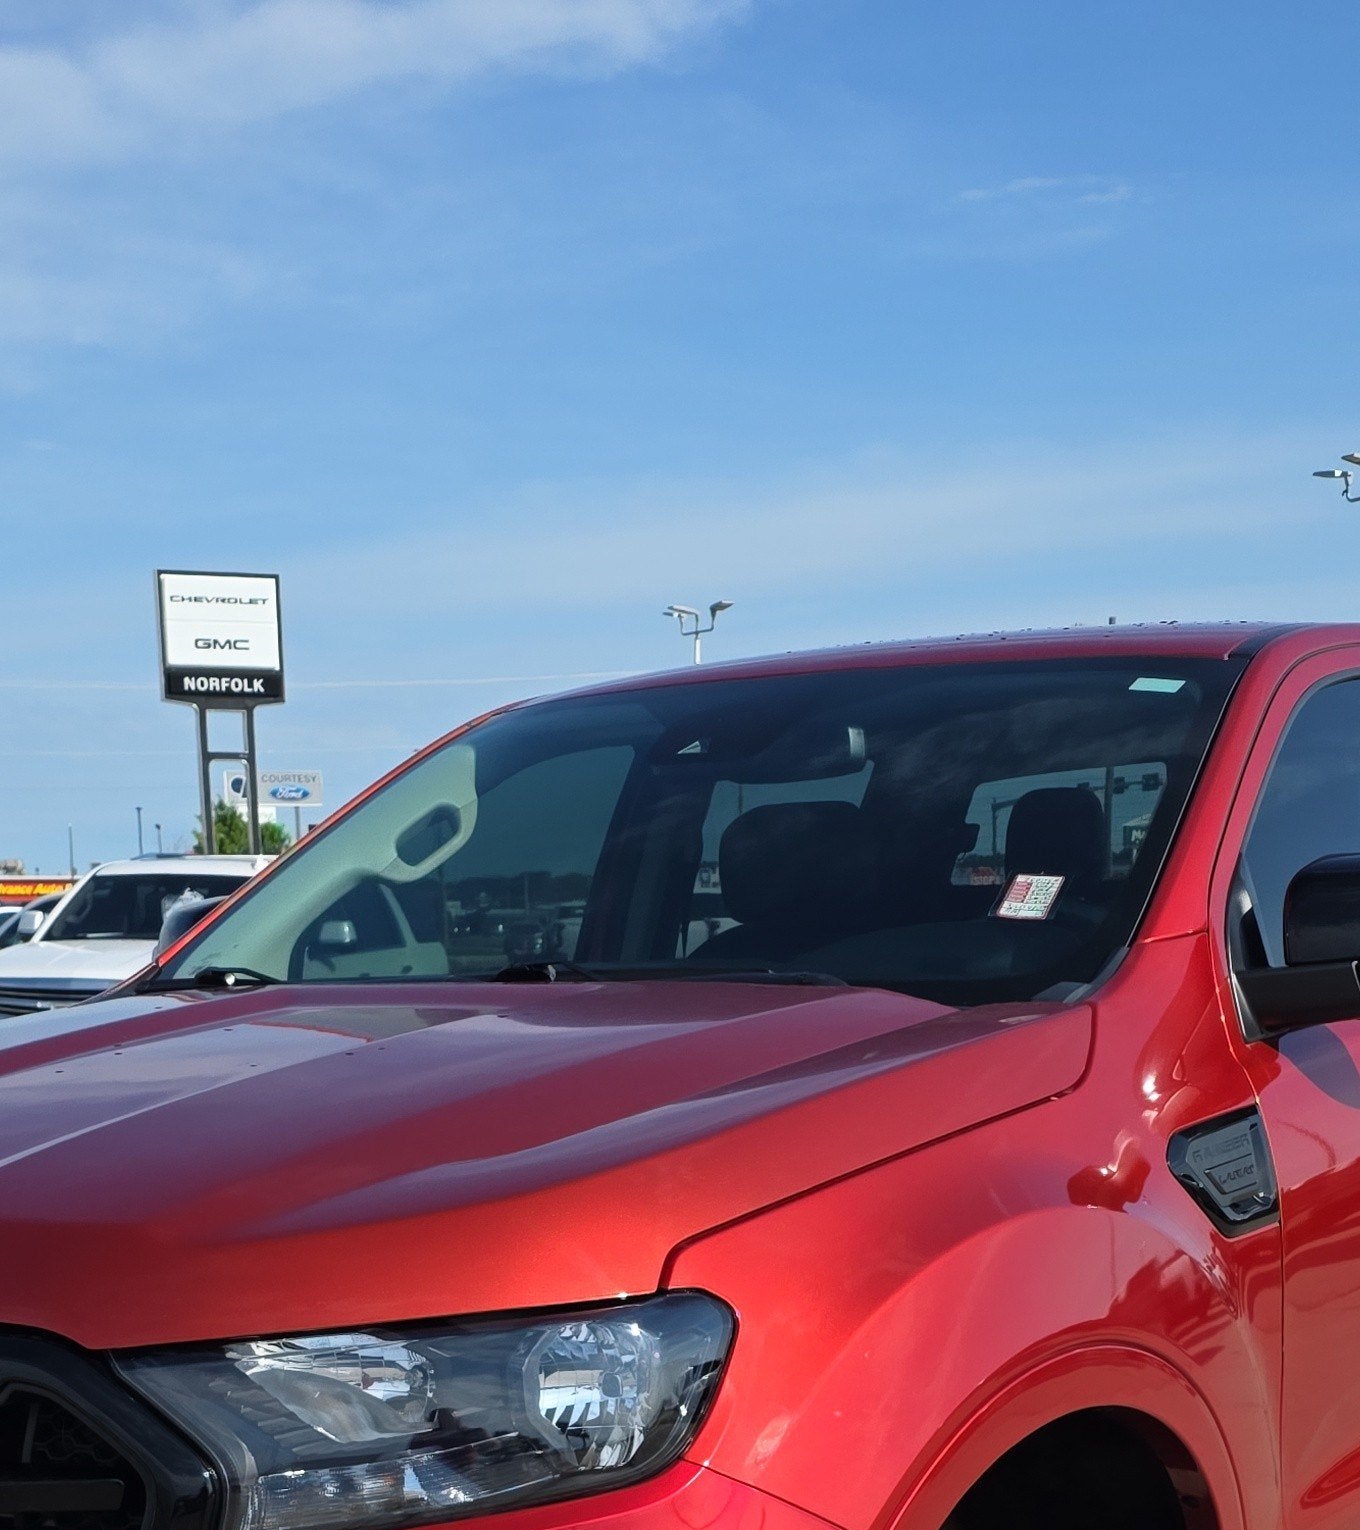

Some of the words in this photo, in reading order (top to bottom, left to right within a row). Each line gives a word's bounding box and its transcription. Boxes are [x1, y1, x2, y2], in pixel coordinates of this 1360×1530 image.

[170, 595, 269, 605] CHEVROLET
[195, 638, 250, 650] GMC
[183, 676, 265, 693] NORFOLK
[261, 774, 317, 784] COURTESY
[277, 785, 304, 799] Ford
